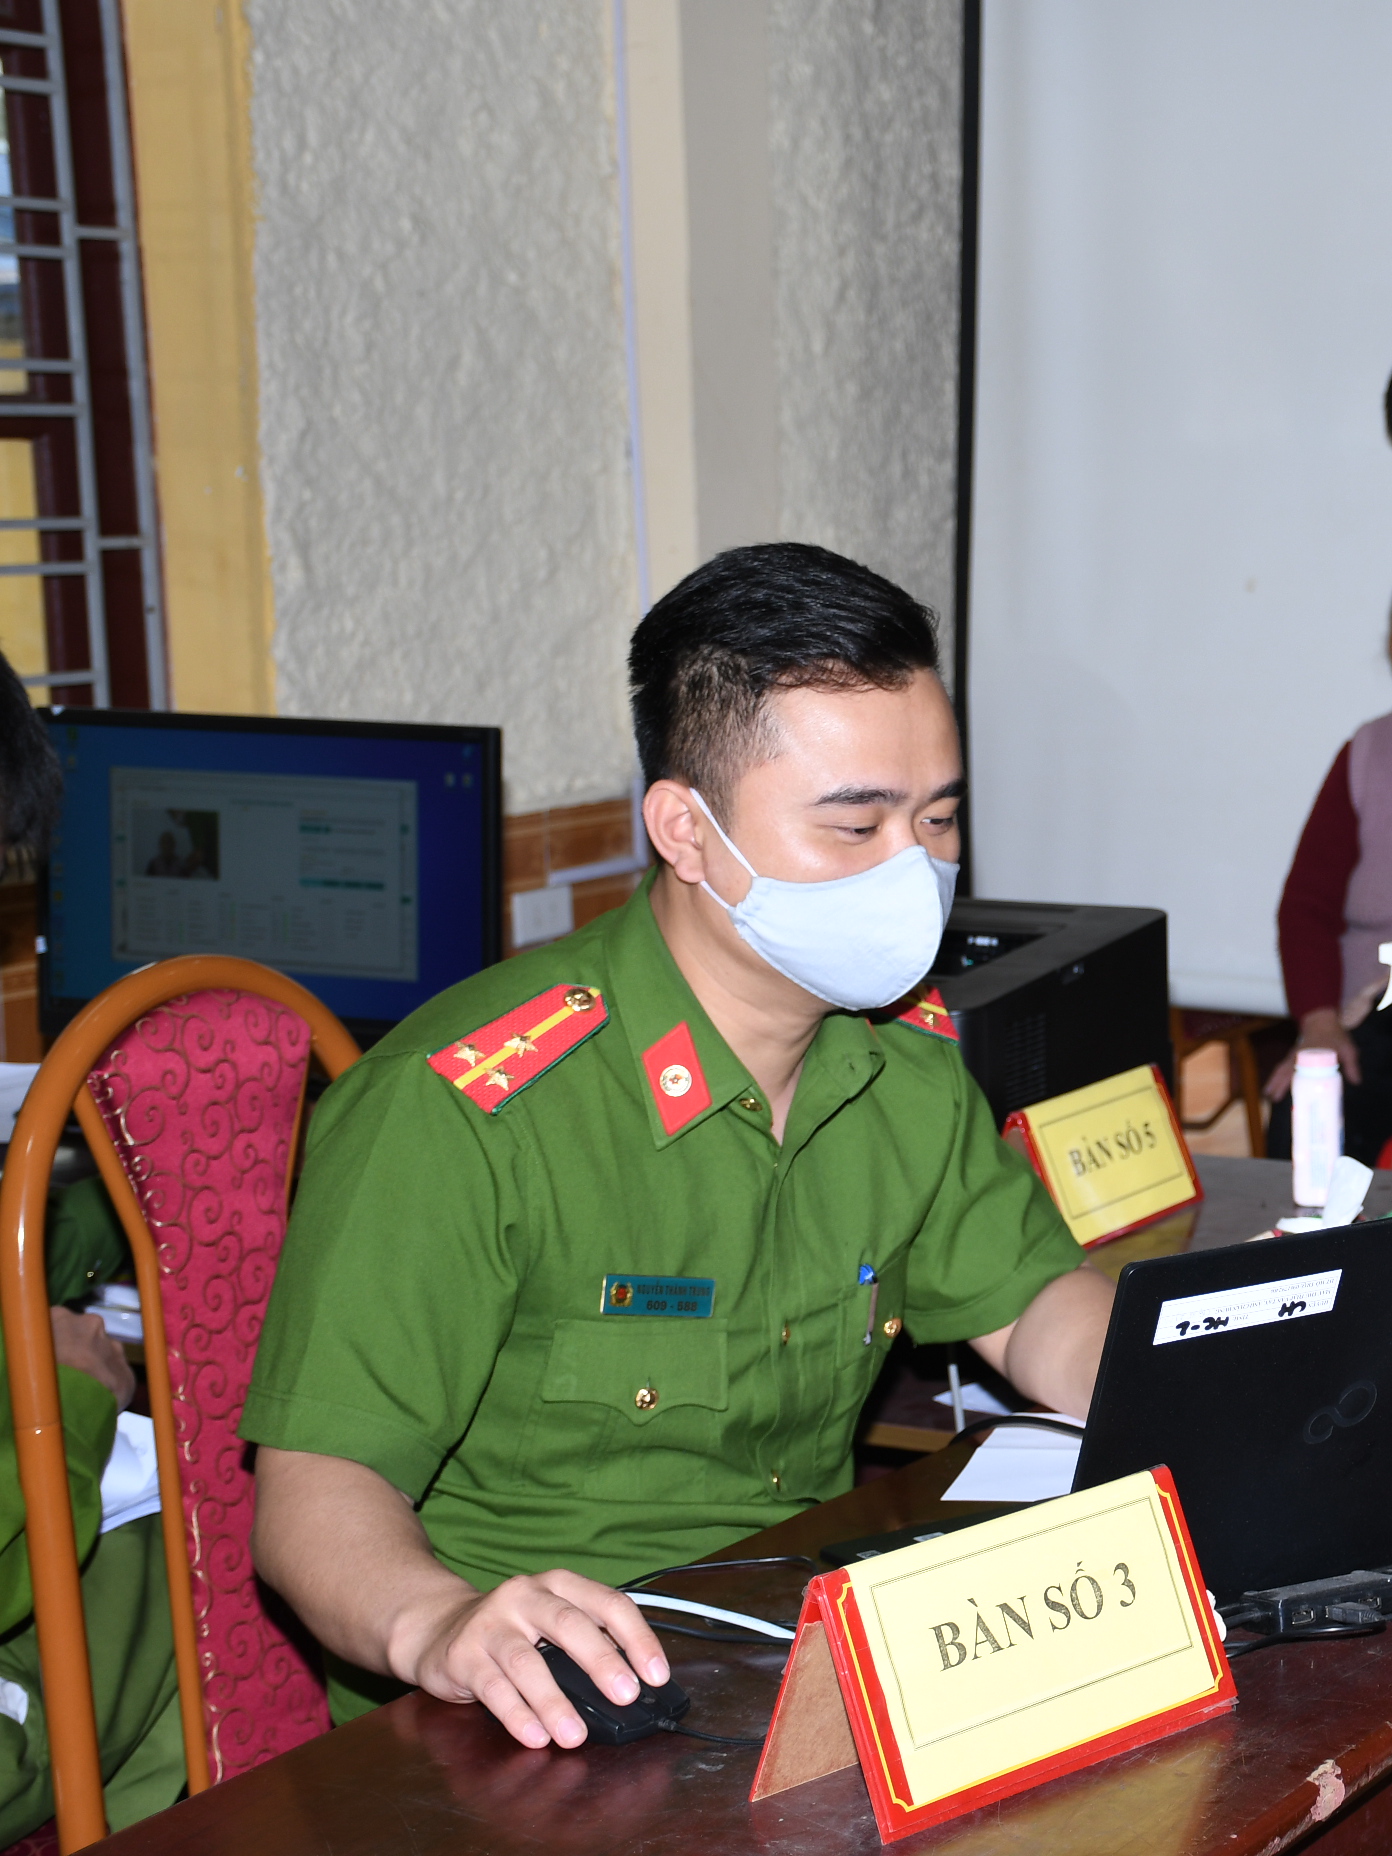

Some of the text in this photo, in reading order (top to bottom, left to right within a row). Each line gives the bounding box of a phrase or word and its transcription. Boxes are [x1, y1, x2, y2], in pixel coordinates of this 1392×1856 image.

[1069, 1134, 1114, 1177] BÀN
[1143, 1122, 1157, 1149] 5
[928, 1561, 1137, 1672] BÀN SỐ 3
